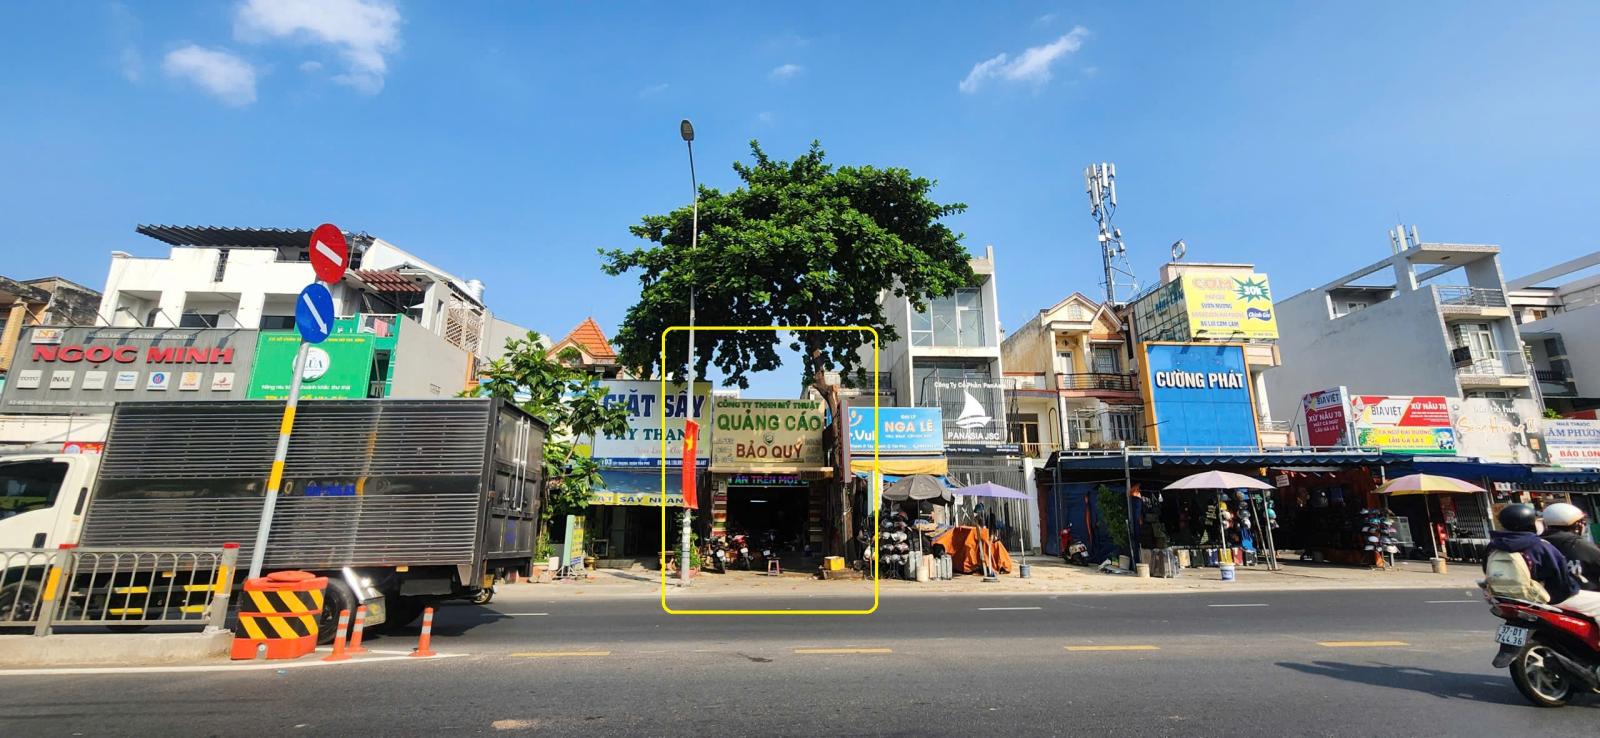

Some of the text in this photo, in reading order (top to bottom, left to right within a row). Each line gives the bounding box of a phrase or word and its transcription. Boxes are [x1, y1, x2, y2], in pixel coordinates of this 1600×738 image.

[32, 345, 235, 369] NGỌC MINH
[1155, 368, 1243, 388] CƯỜNG PHÁT
[665, 387, 705, 418] SẤY
[717, 400, 820, 411] CÔNG TY TNHH MỸ THUẬT
[717, 409, 821, 431] QUẢNG CÁO
[884, 421, 916, 433] NGA
[643, 428, 701, 445] THẠN
[947, 431, 1000, 440] PANASIA JSC
[1545, 427, 1565, 437] ÂM
[736, 440, 767, 458] BẢO
